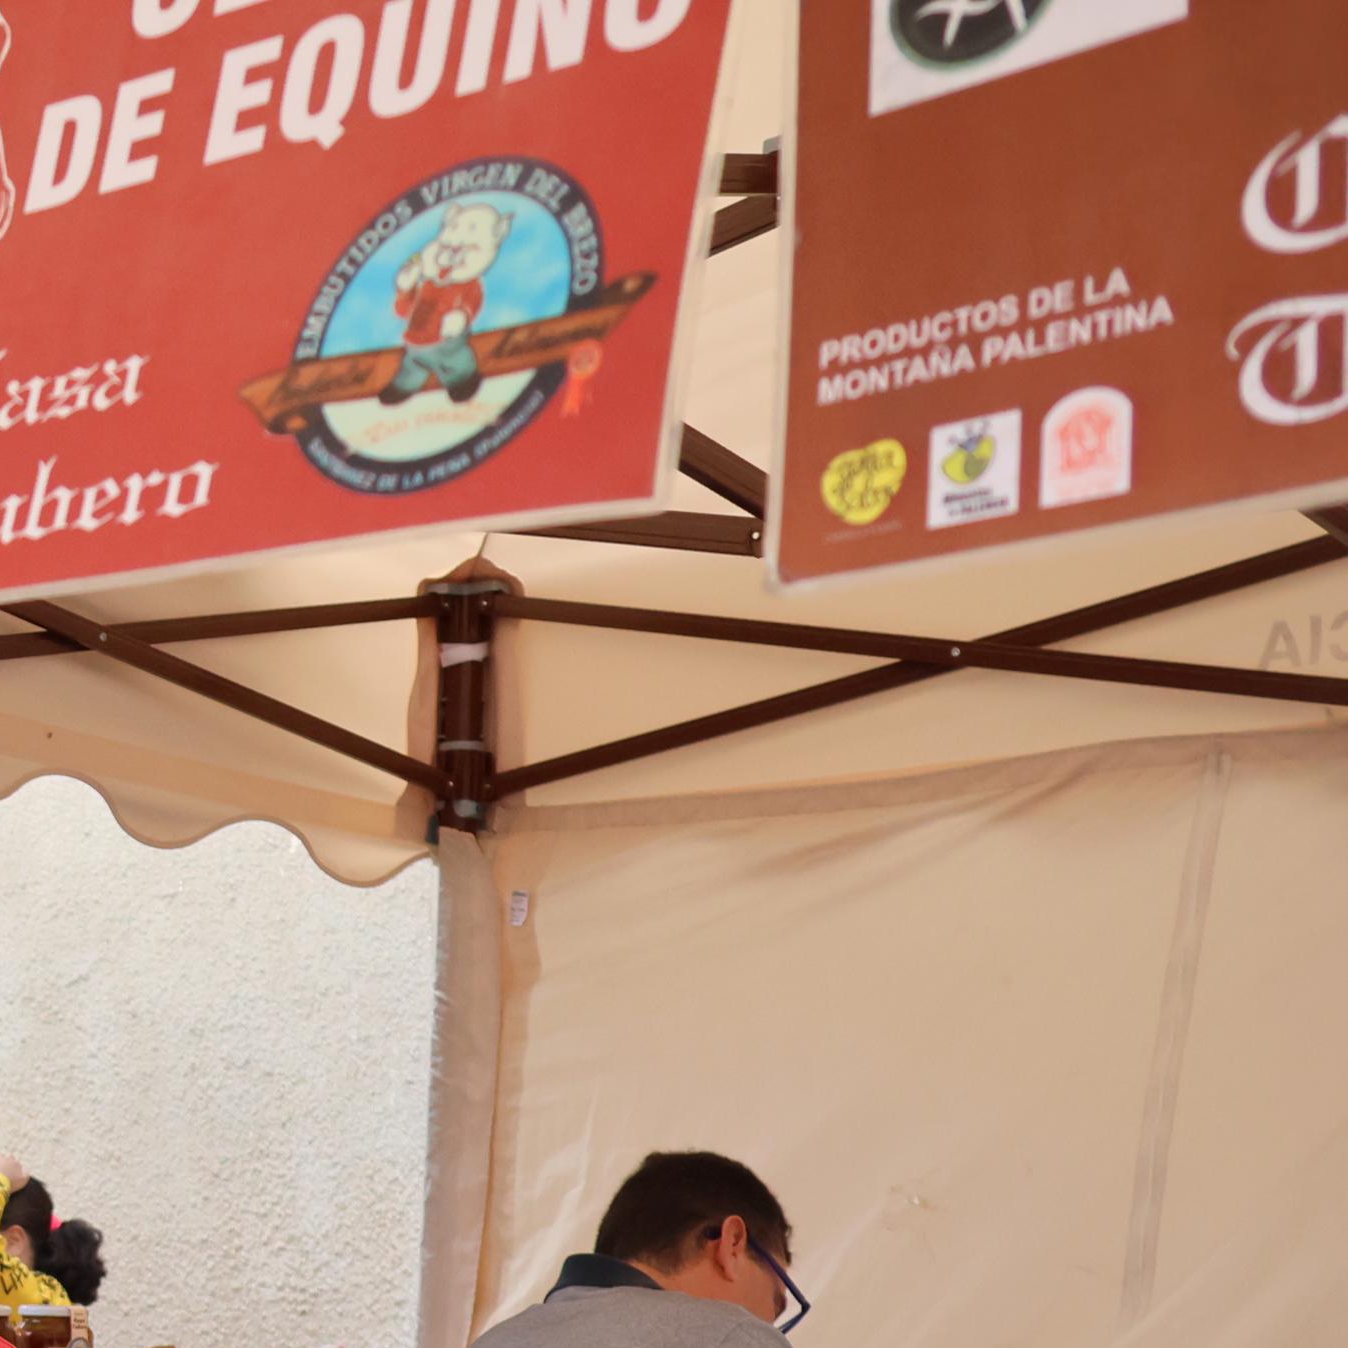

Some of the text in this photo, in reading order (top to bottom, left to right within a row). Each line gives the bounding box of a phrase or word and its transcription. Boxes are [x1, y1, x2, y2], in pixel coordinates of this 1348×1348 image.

[23, 68, 175, 214] DE
[297, 200, 412, 359] EMBUTIDOS
[421, 163, 522, 206] VIRGEN
[525, 168, 569, 210] DEL
[562, 203, 599, 296] BREZO
[818, 267, 1131, 370] PRODUCTOS DE LA
[816, 342, 977, 406] MONTAÑA
[981, 295, 1175, 368] PALENTINA
